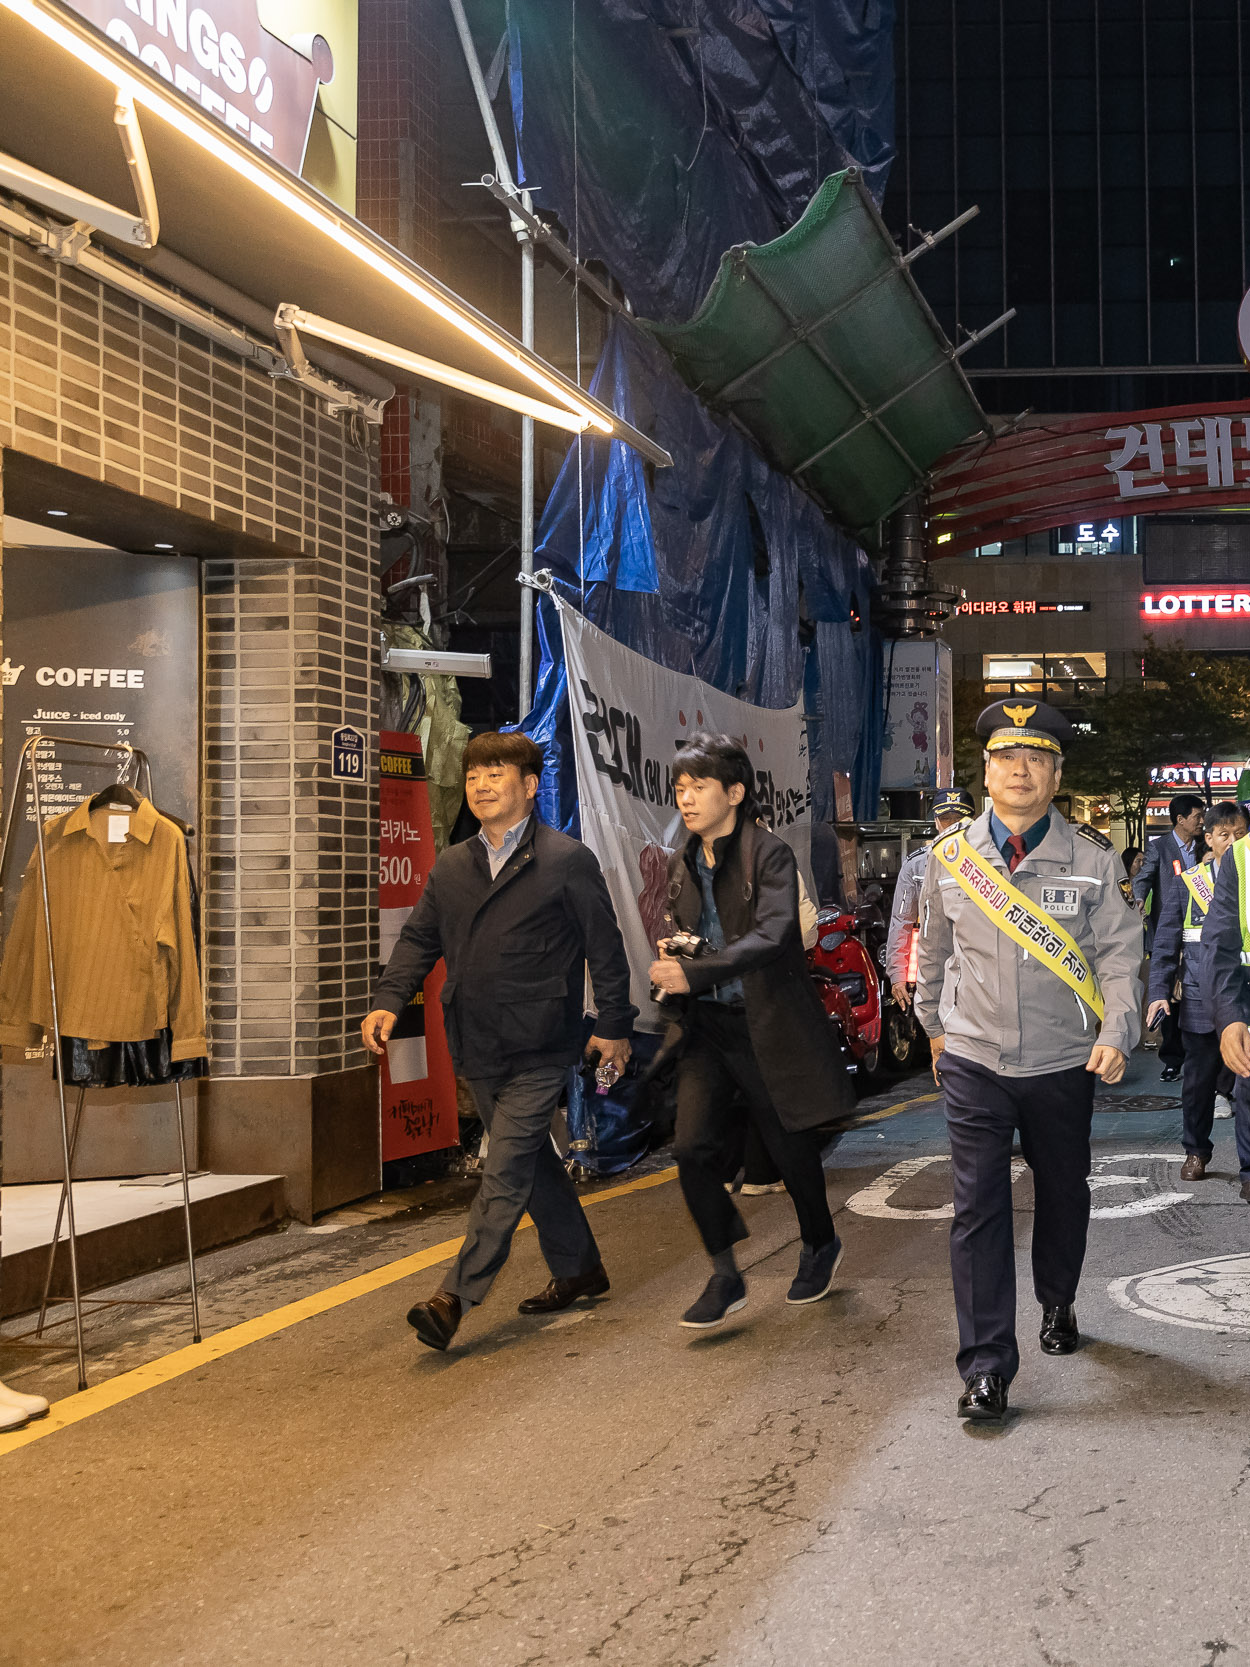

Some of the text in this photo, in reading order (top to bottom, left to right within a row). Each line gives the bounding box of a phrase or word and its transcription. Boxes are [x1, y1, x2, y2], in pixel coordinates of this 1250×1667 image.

[35, 667, 145, 689] COFFEE
[33, 708, 71, 720] Juice
[80, 711, 102, 721] iced
[104, 712, 126, 723] only
[338, 752, 359, 774] 119
[380, 755, 412, 775] COFFEE
[1044, 888, 1076, 903] 경찰
[1044, 904, 1076, 912] POLICE
[958, 857, 1088, 984] 범죄없는 건대맛의 거리
